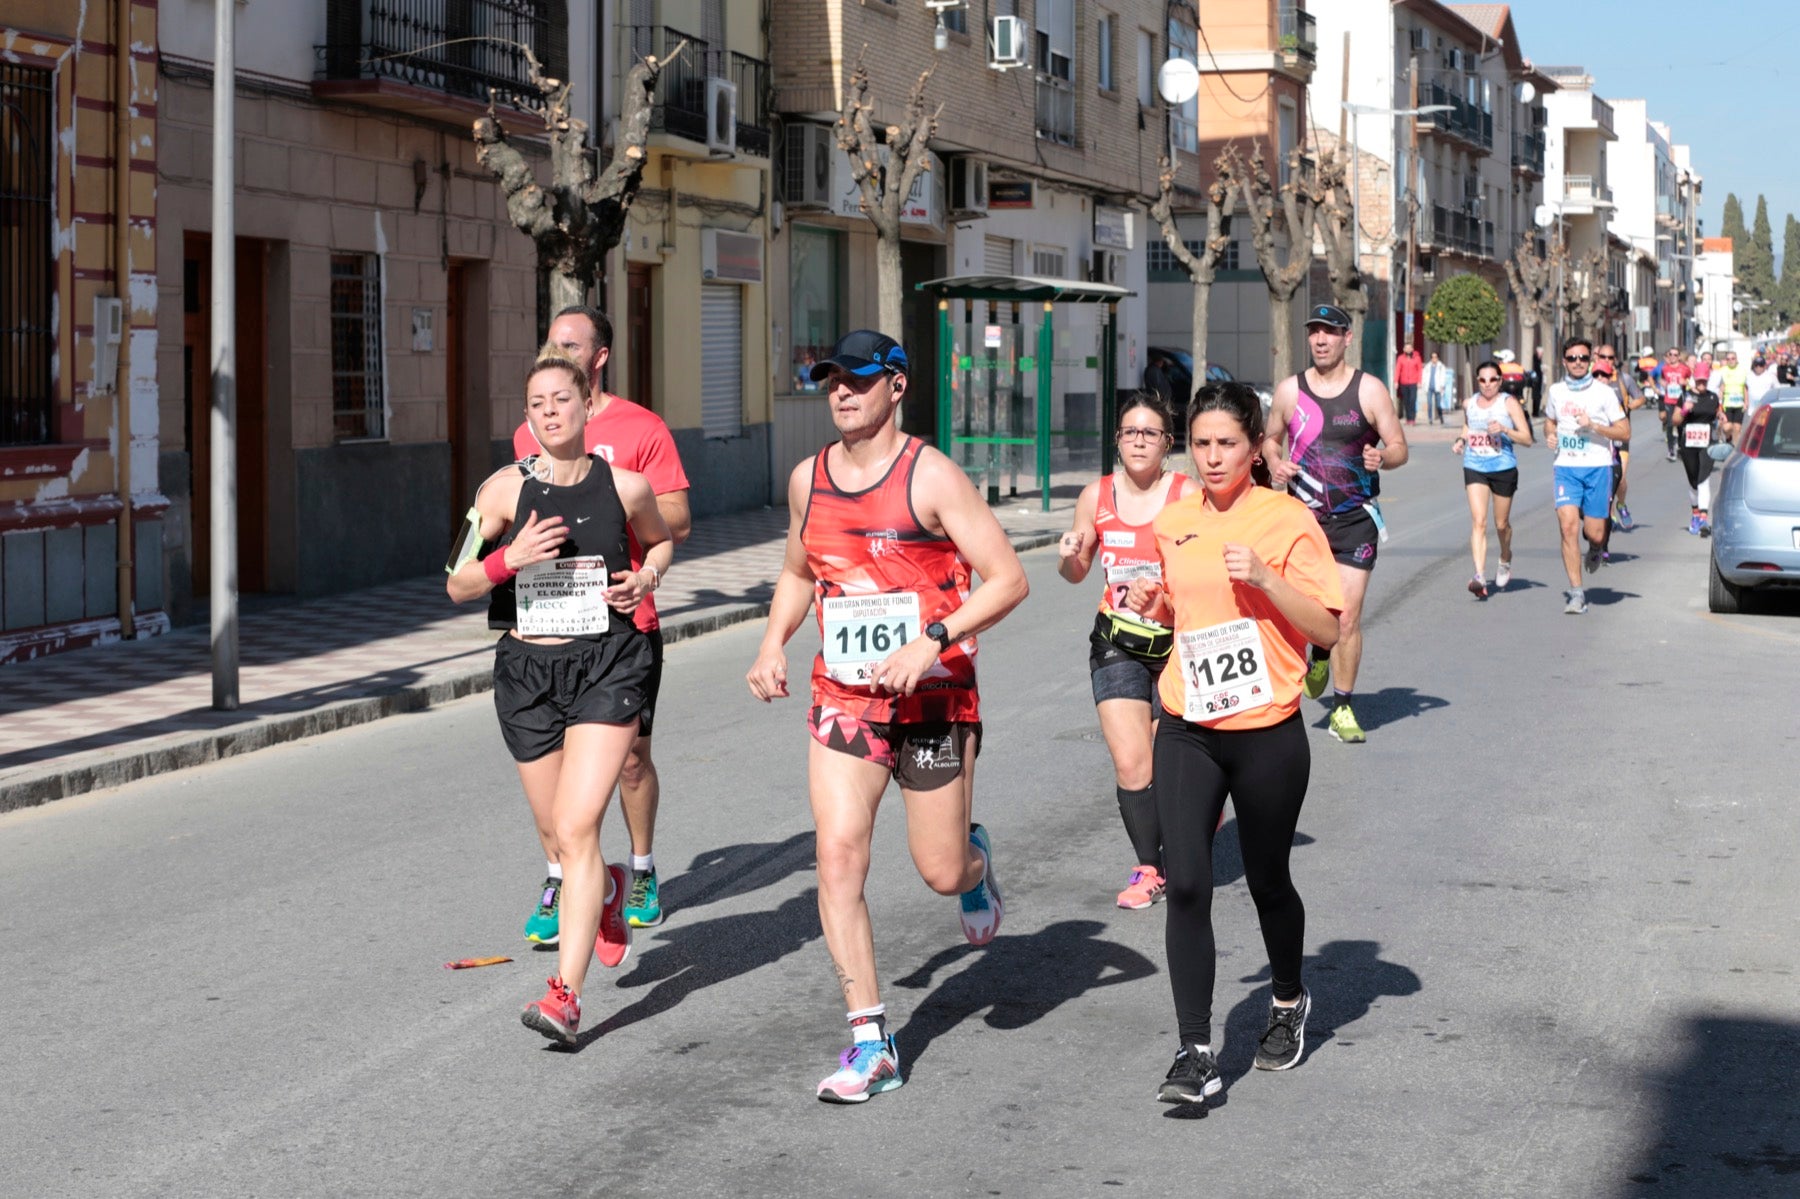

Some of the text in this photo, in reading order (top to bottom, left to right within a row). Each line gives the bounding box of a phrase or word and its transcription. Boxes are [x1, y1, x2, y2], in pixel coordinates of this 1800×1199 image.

[532, 581, 565, 589] CORRO
[567, 580, 604, 589] CONTRA
[535, 601, 567, 610] aecc
[844, 599, 860, 609] GRAN
[861, 598, 882, 608] PREMIO
[884, 597, 891, 606] DE
[892, 596, 913, 605] FONDO
[1196, 628, 1219, 641] PREMIO
[1220, 625, 1228, 636] DE
[1228, 621, 1250, 633] FONDO
[836, 621, 908, 655] 1161
